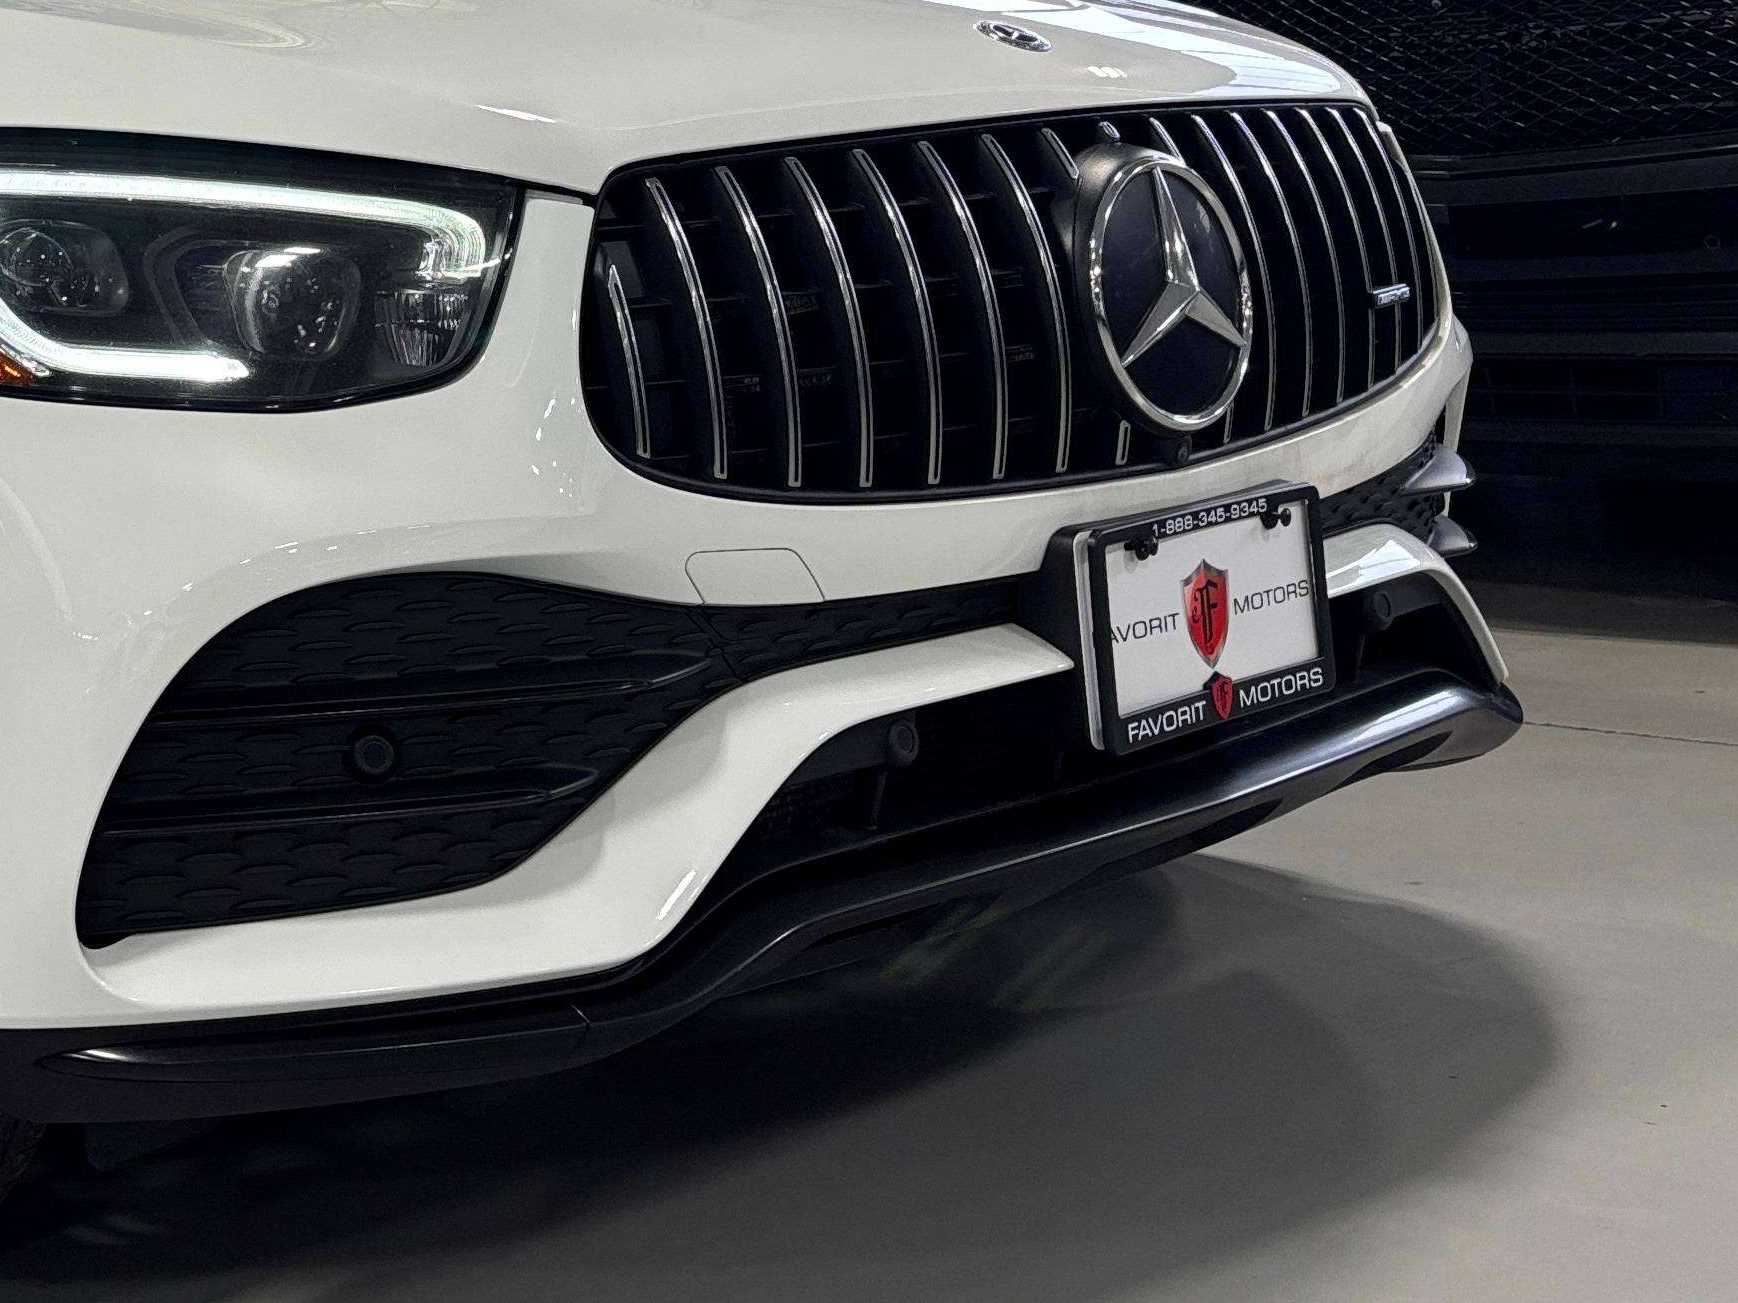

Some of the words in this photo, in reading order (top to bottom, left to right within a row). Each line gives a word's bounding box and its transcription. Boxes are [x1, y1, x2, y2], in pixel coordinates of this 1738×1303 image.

[1151, 498, 1268, 536] 1-888-345-9345
[1109, 612, 1180, 644] AVORIT
[1233, 579, 1310, 615] MOTORS
[1127, 700, 1207, 744] FAVORIT
[1238, 667, 1324, 708] MOTORS
